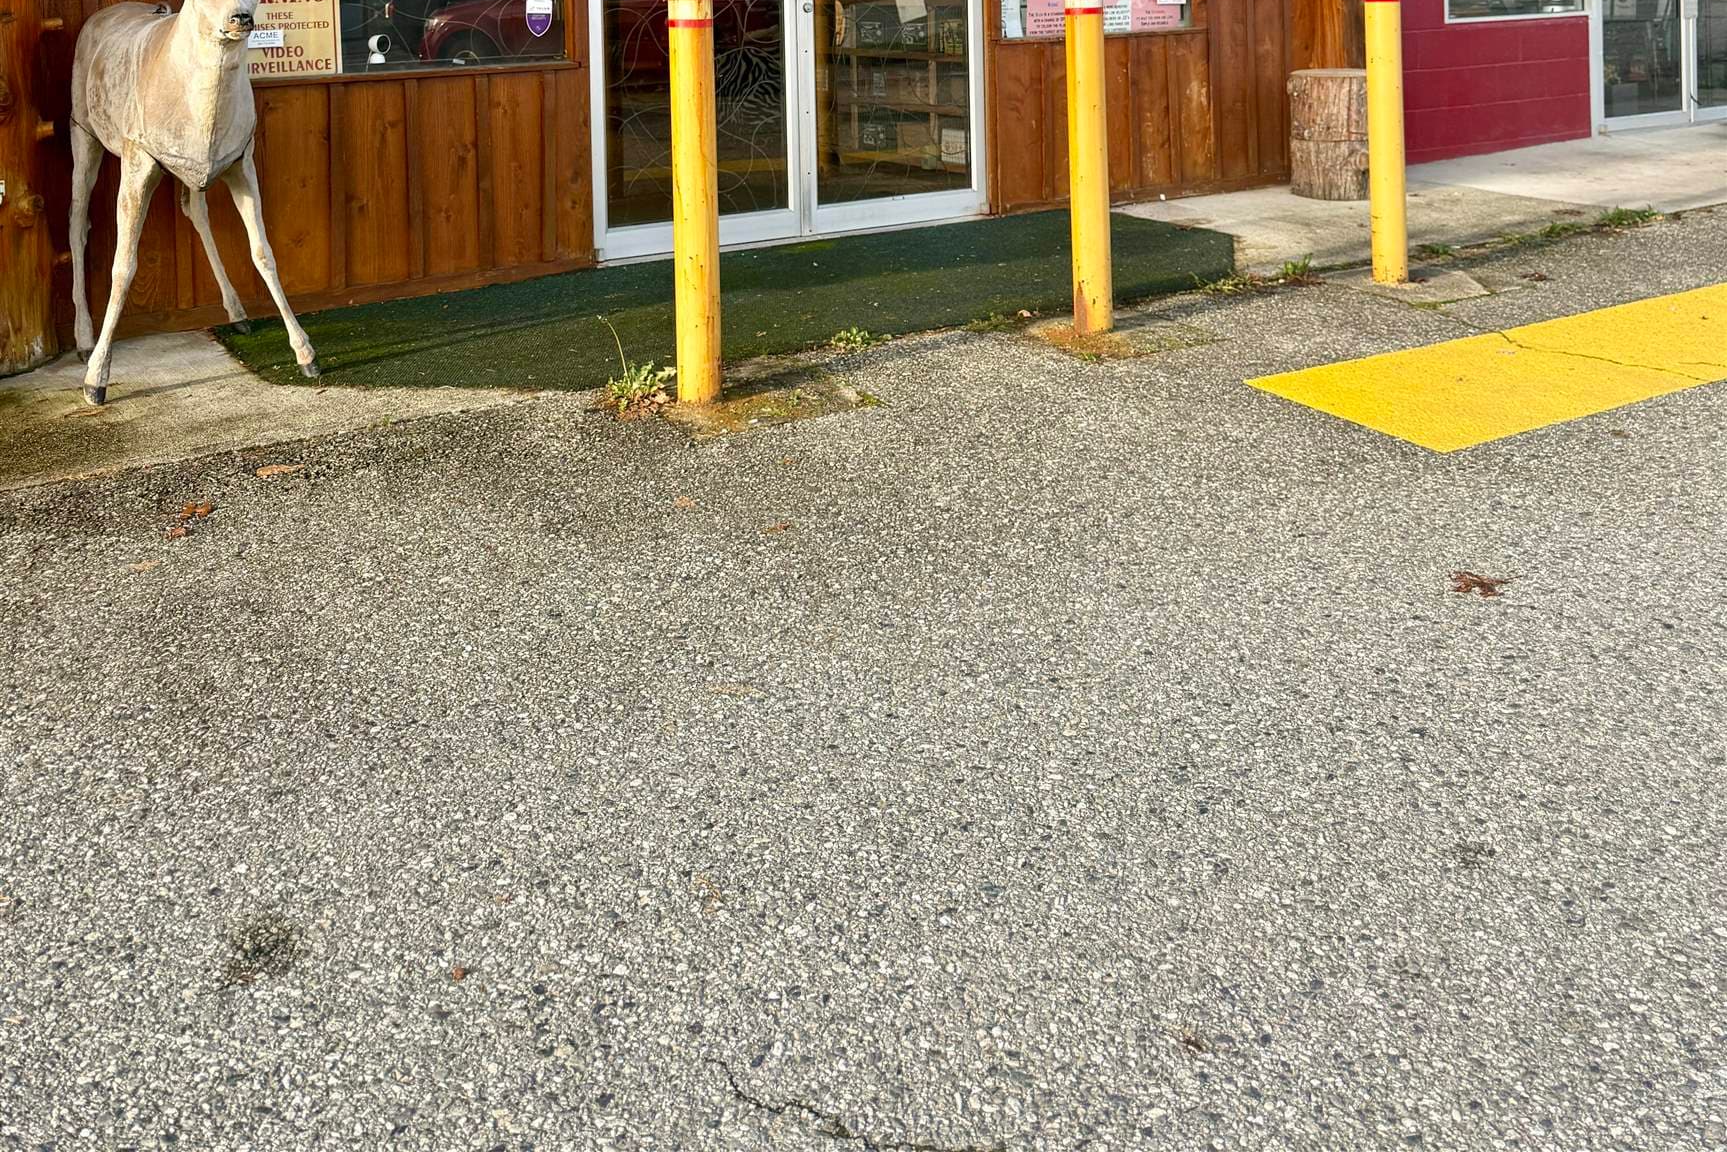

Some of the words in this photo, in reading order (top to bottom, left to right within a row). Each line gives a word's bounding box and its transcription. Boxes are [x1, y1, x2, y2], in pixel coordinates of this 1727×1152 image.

[266, 12, 294, 20] THESE
[254, 22, 276, 31] ISES
[278, 20, 330, 30] PROTECTED
[253, 32, 279, 40] ACME
[262, 46, 304, 59] VIDEO
[247, 58, 333, 75] RVEILLANCE
